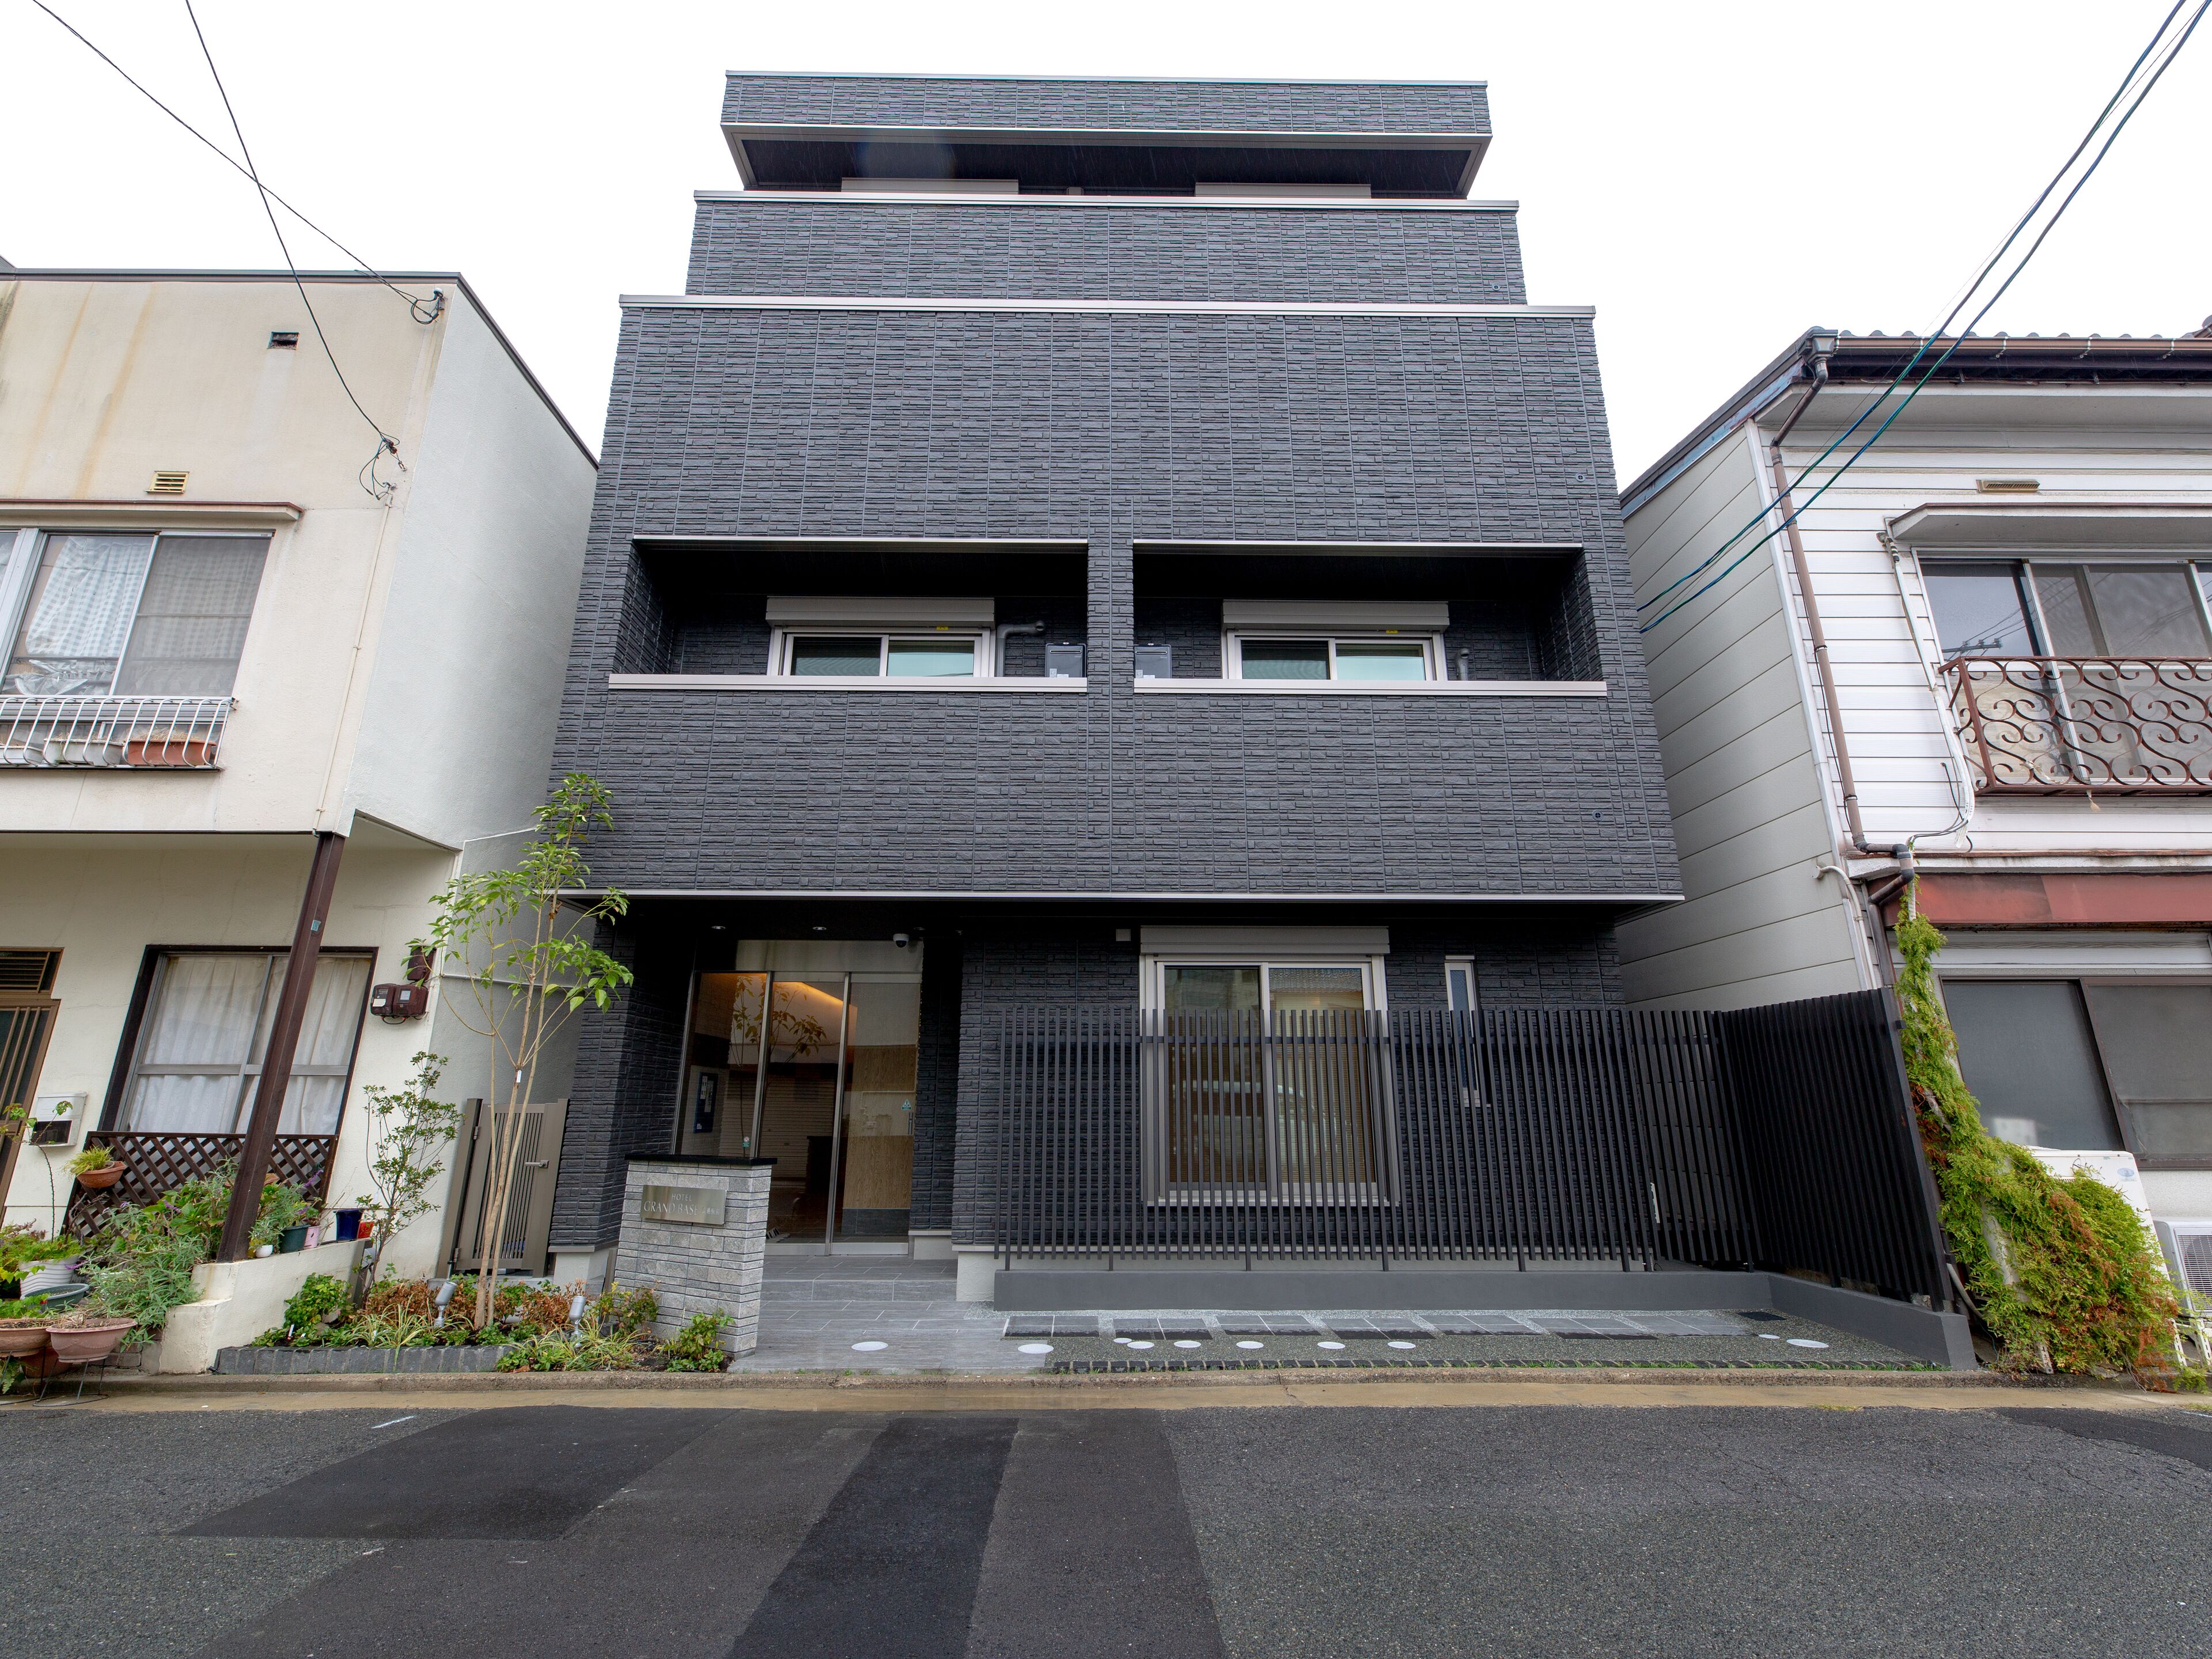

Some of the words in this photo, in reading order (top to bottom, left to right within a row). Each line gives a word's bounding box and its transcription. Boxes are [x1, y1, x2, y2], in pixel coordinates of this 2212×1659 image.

[671, 1193, 692, 1202] HOTEL
[643, 1200, 675, 1213] GRAND
[678, 1203, 697, 1215] BASE
